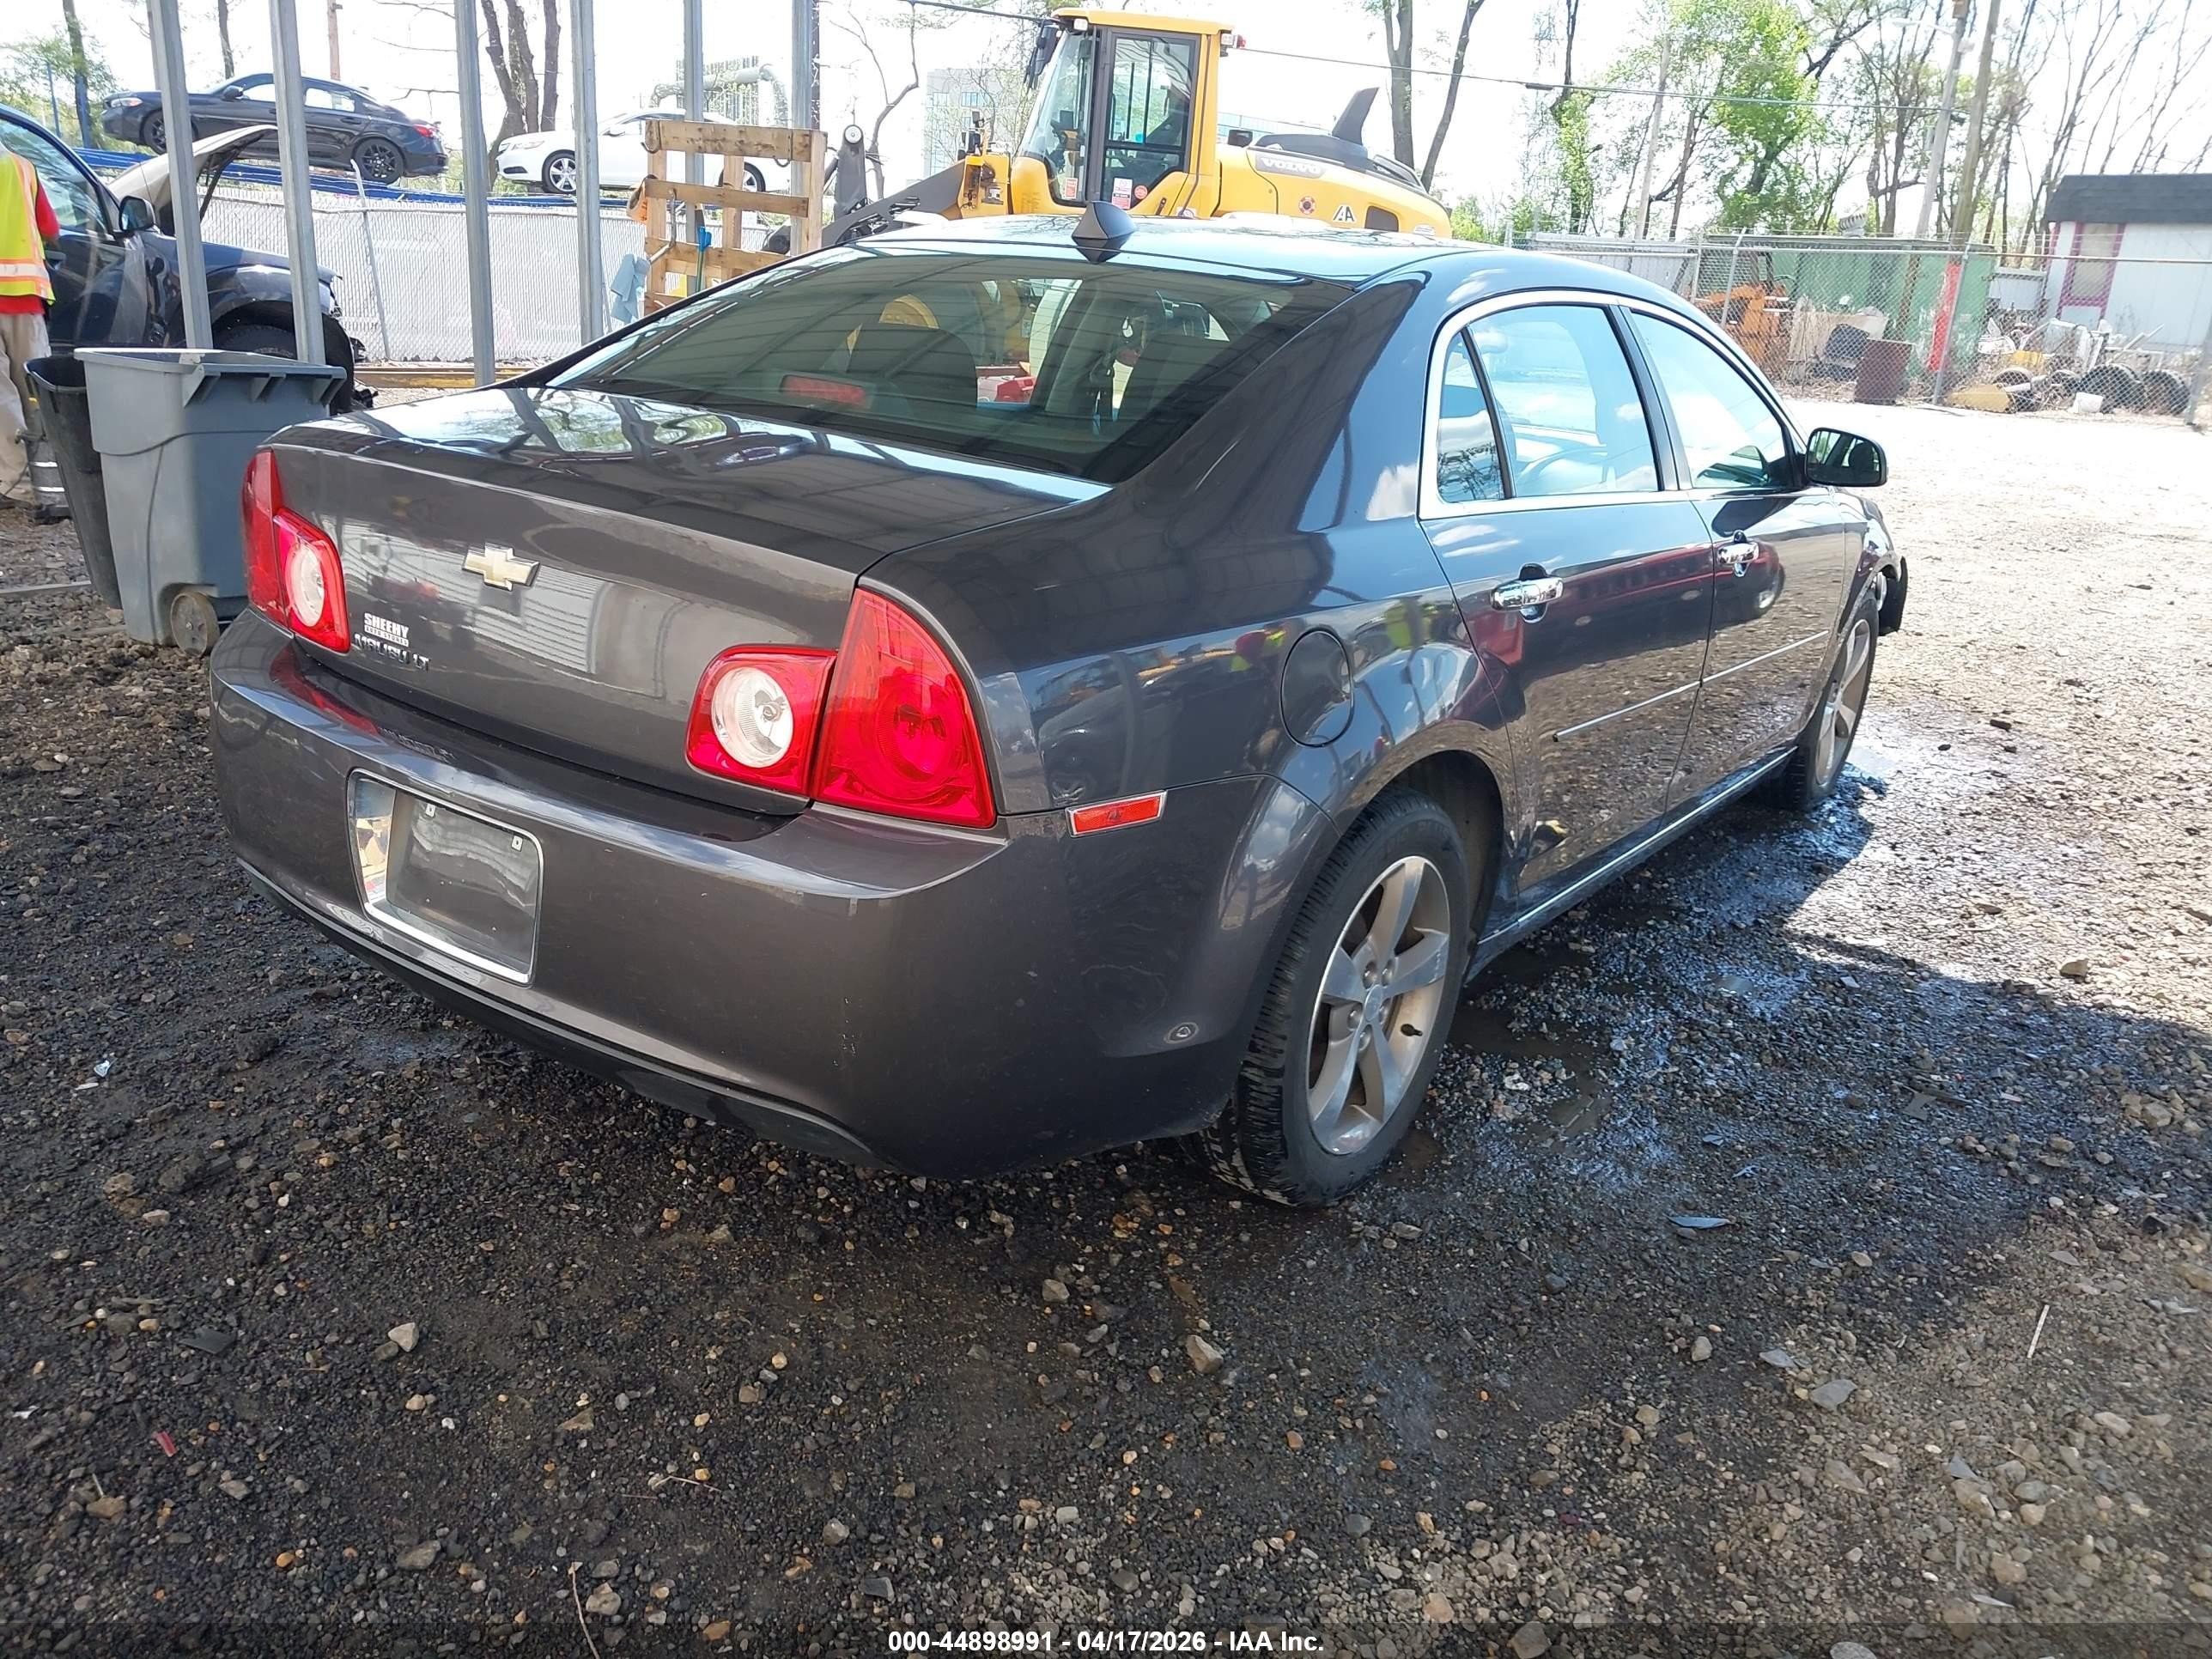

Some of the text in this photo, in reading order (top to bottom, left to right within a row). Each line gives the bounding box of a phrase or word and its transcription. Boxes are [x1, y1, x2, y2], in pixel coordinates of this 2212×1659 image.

[1261, 157, 1322, 174] VOLVO
[364, 612, 409, 639] SHEEHY
[412, 653, 431, 672] LT
